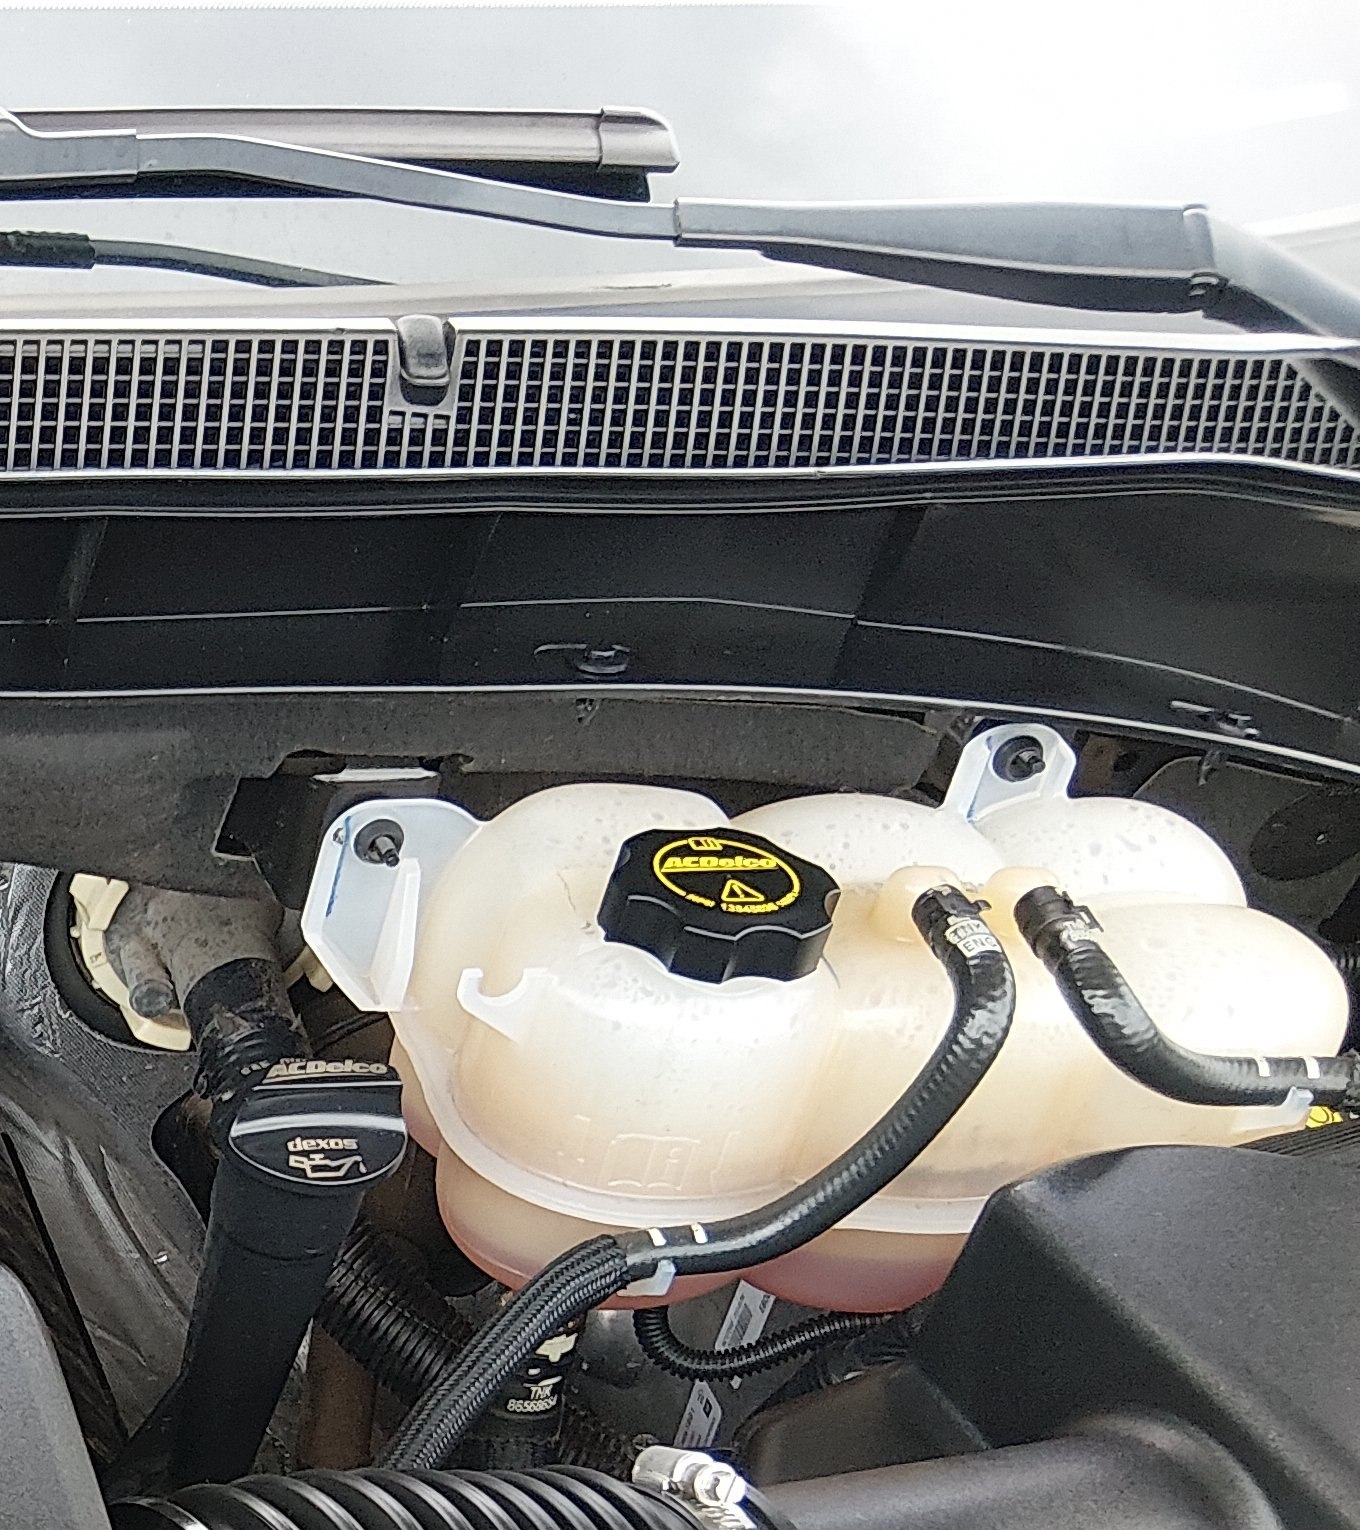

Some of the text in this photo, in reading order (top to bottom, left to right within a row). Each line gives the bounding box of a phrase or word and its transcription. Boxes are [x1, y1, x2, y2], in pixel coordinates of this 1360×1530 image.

[663, 856, 778, 870] ACDelco
[264, 1059, 389, 1081] ACDelco
[287, 1137, 359, 1151] dexos
